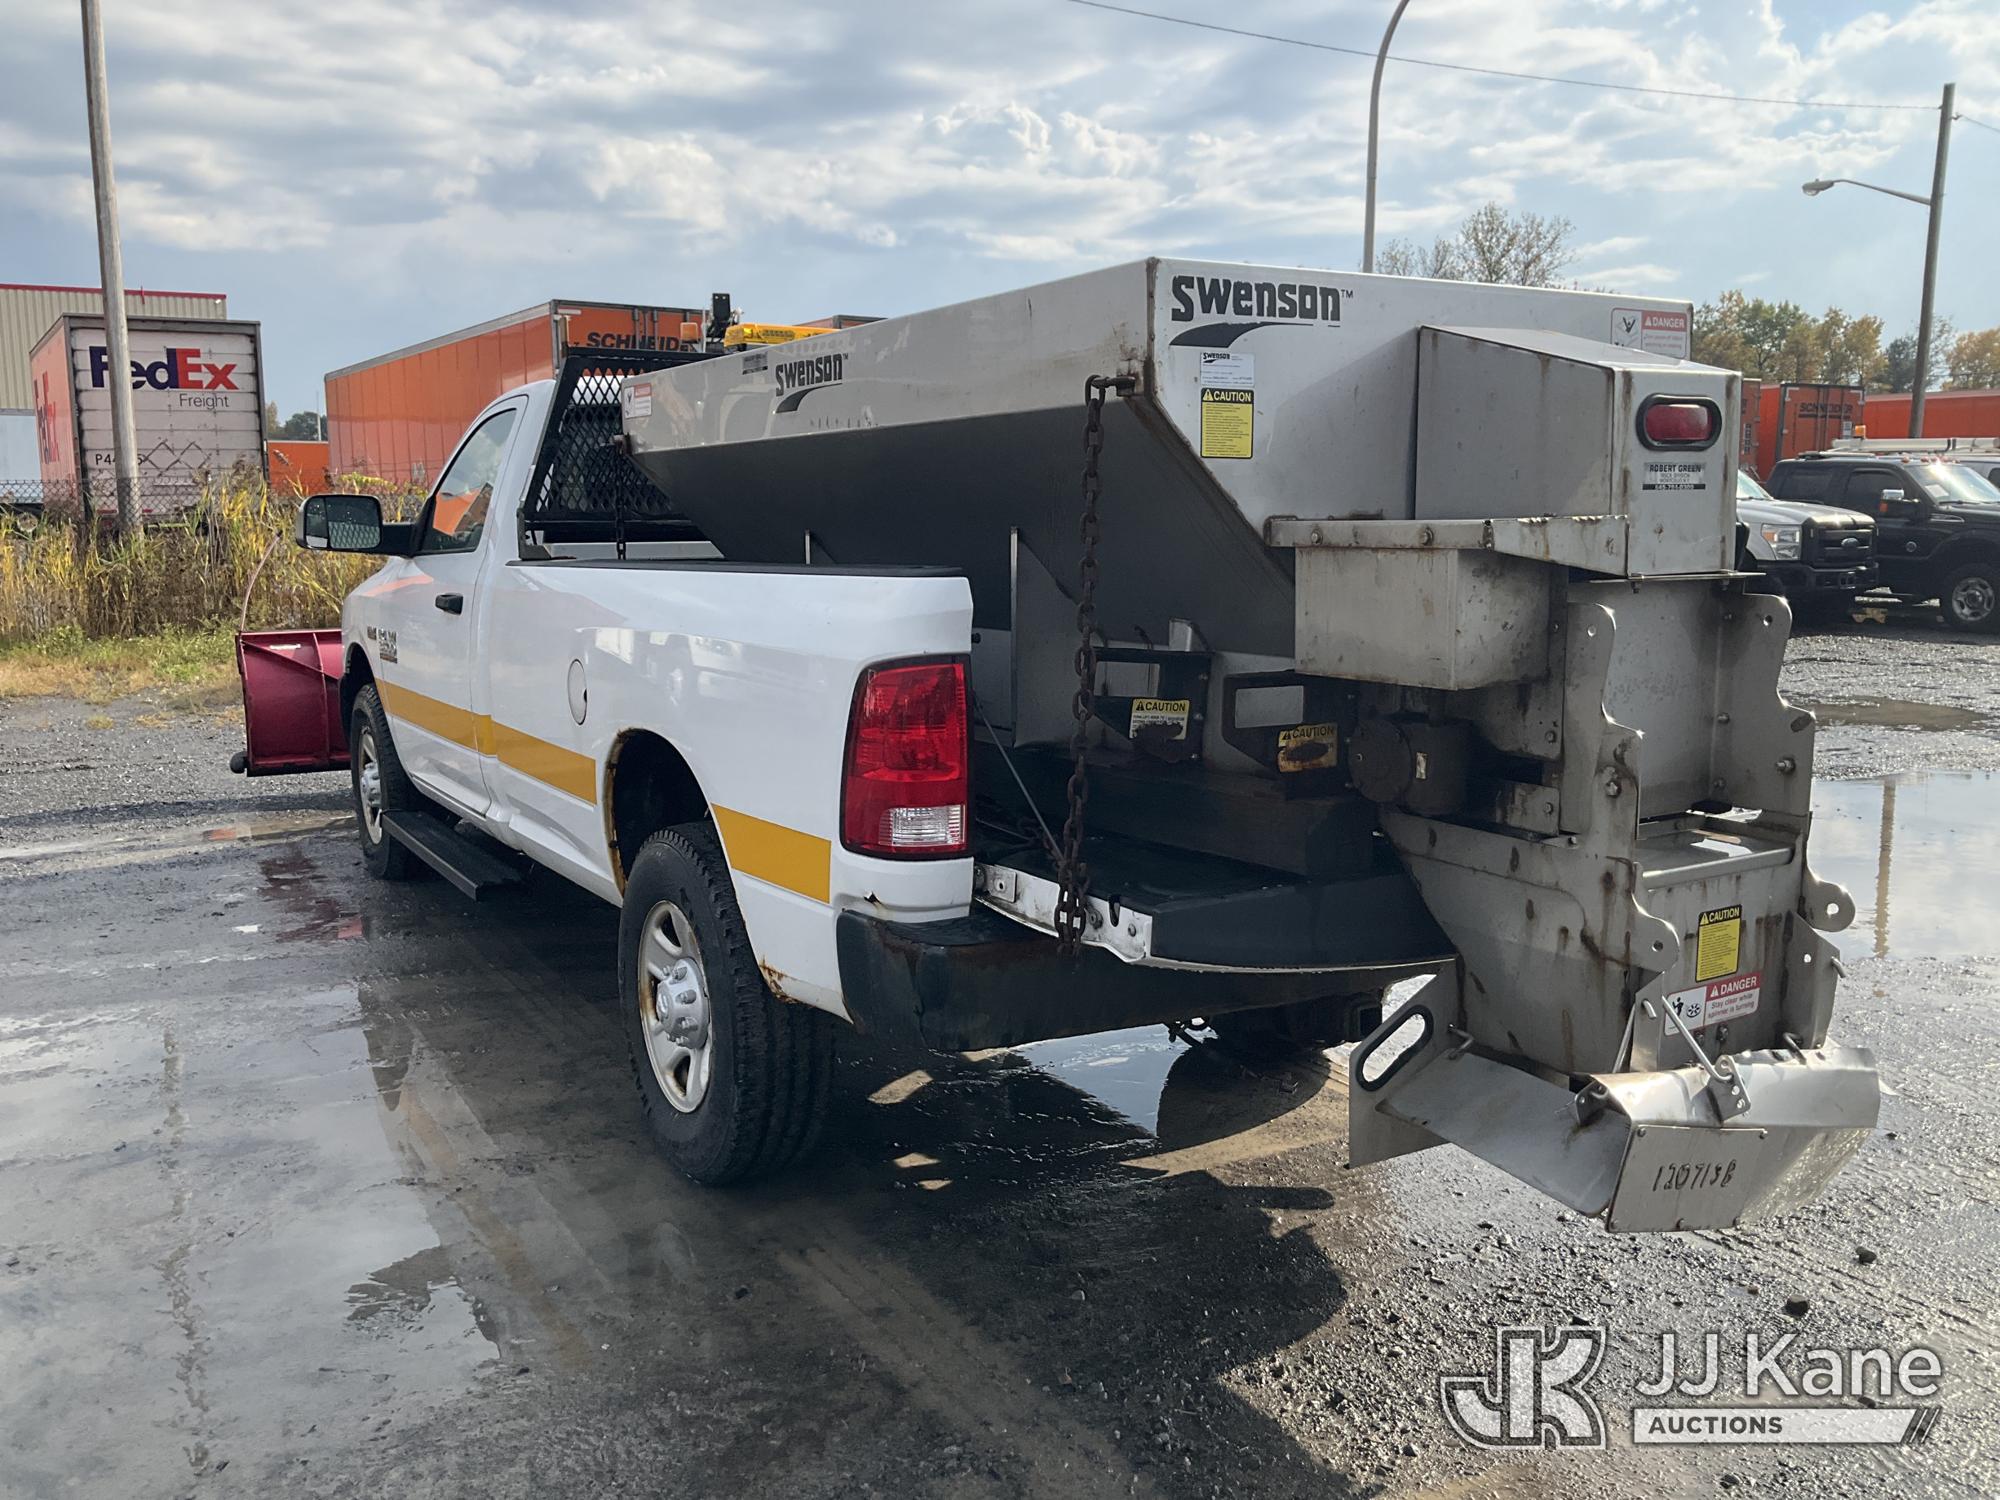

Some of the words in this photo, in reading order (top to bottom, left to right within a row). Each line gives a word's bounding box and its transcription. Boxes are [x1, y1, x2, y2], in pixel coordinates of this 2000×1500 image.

[1171, 275, 1340, 322] Swenson
[1652, 316, 1685, 328] DANGER
[775, 353, 843, 397] Swenson
[179, 393, 230, 410] Freight
[1213, 390, 1252, 403] CAUTION
[1649, 464, 1676, 472] ROBERT
[1678, 464, 1701, 472] GREEN
[1145, 701, 1186, 711] CAUTION
[1292, 726, 1334, 738] CAUTION
[1709, 907, 1740, 922] CAUTION
[1720, 976, 1757, 995] DANGER
